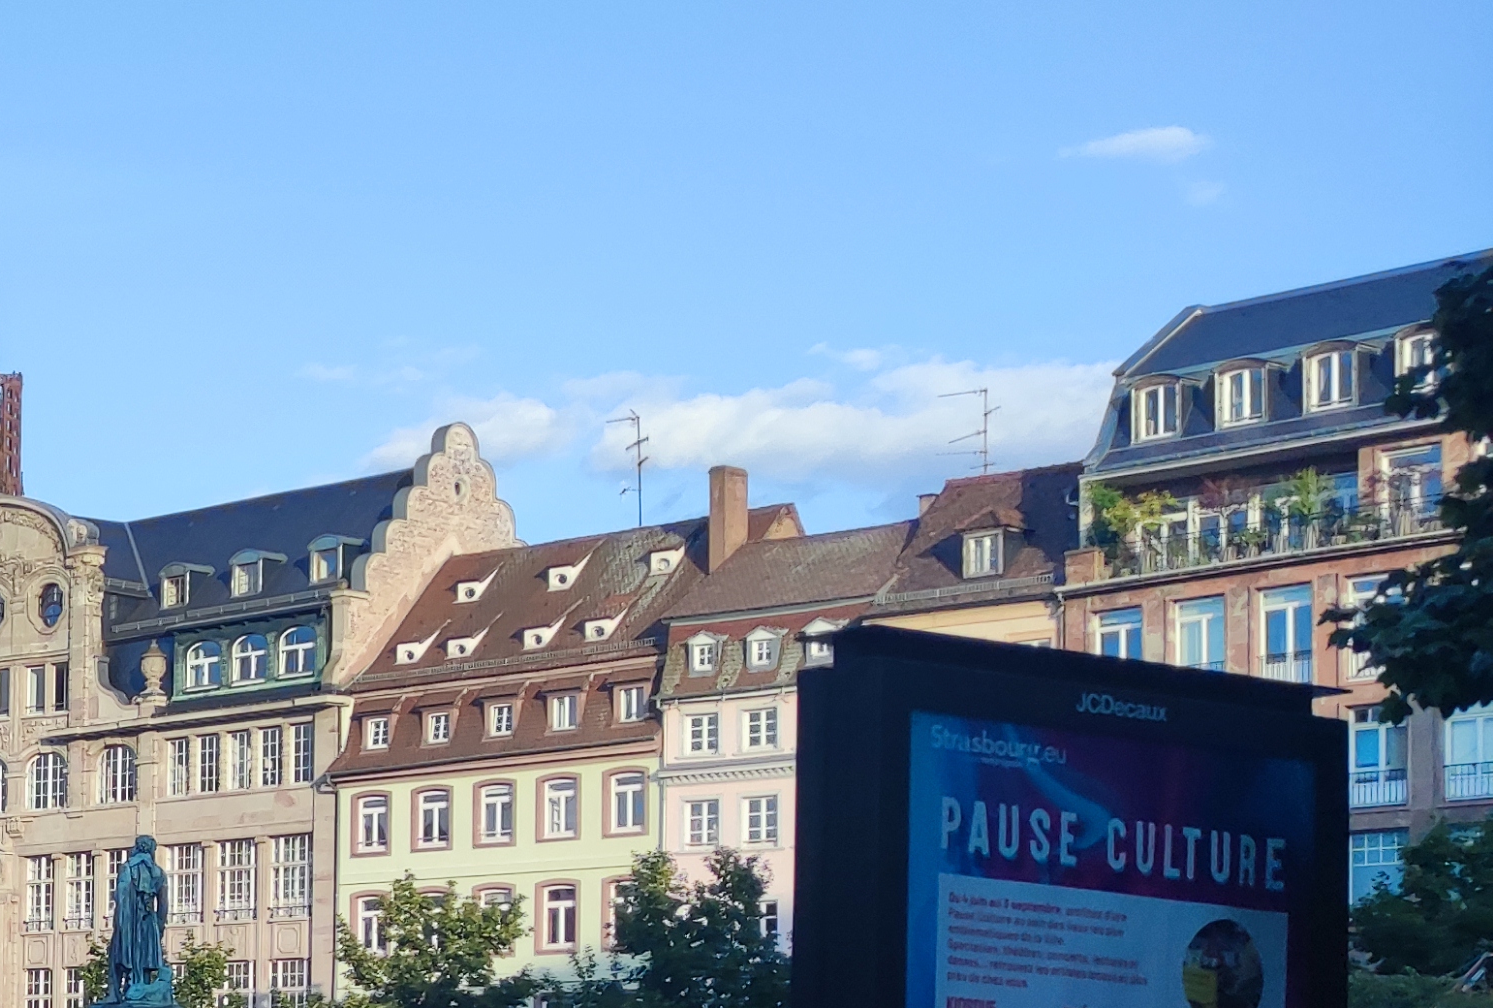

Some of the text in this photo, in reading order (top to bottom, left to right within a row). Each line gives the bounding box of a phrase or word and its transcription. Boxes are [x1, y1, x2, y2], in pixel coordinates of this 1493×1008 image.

[1075, 691, 1168, 722] JCDecaux
[930, 724, 1067, 767] Strasbourg.eu
[940, 795, 1287, 890] PAUSE CULTURE
